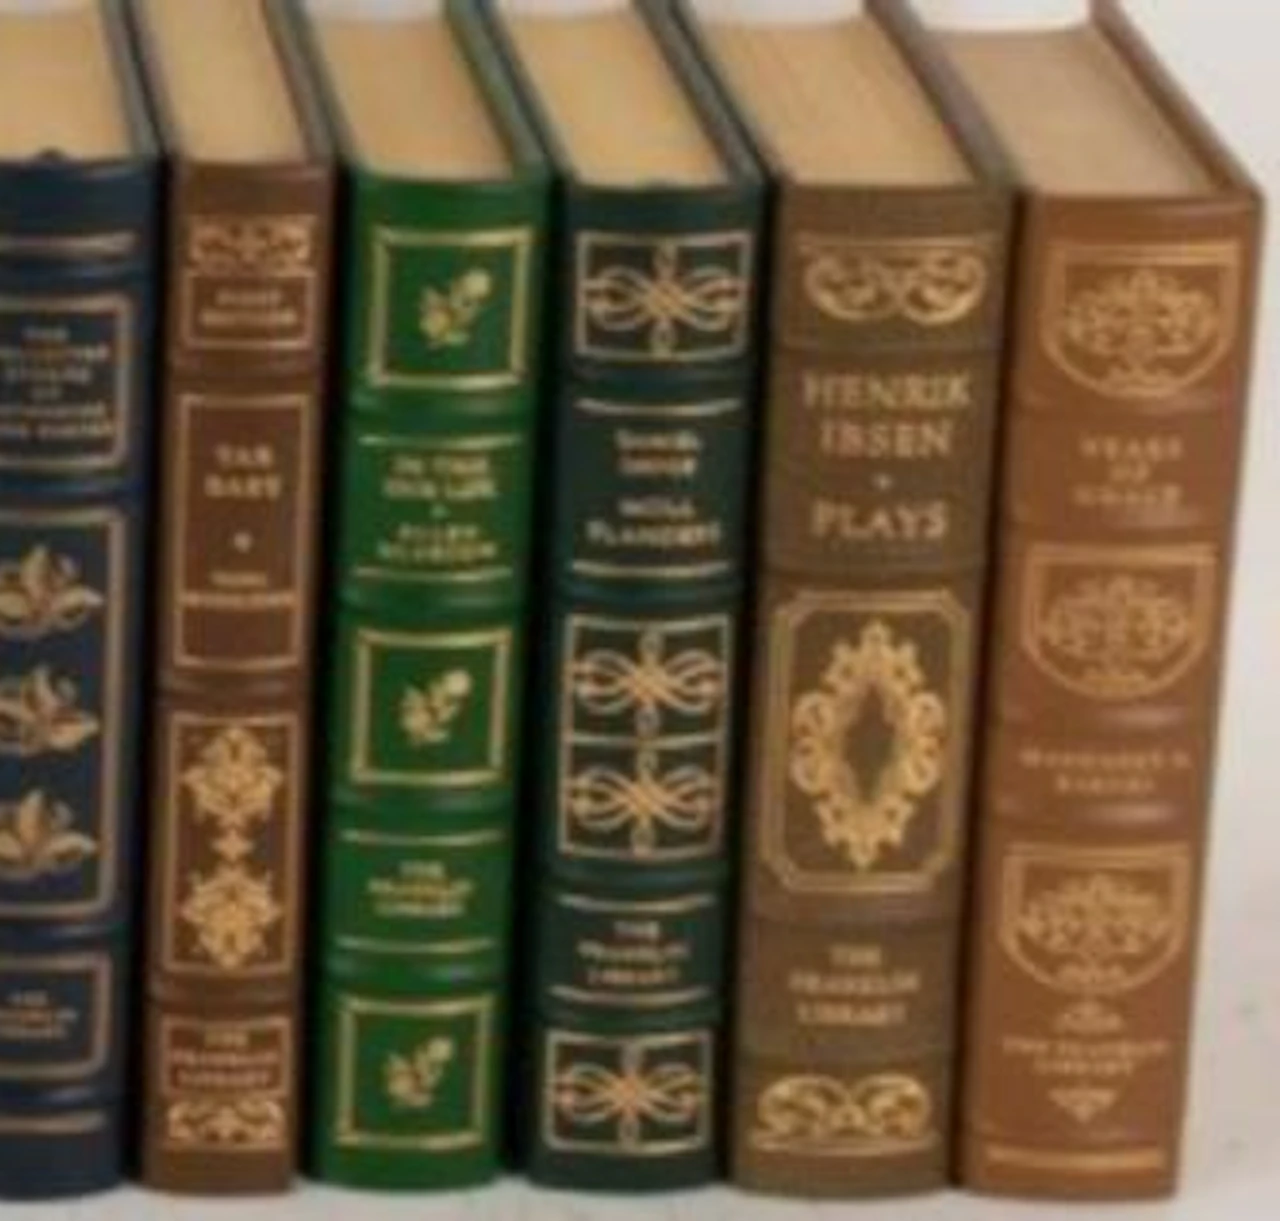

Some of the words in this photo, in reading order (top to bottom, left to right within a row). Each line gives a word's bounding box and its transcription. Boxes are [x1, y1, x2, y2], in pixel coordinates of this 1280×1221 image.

[803, 372, 971, 411] HENRIK
[818, 419, 953, 459] IBSEN
[809, 499, 950, 543] PLAYS
[827, 942, 884, 967] THE
